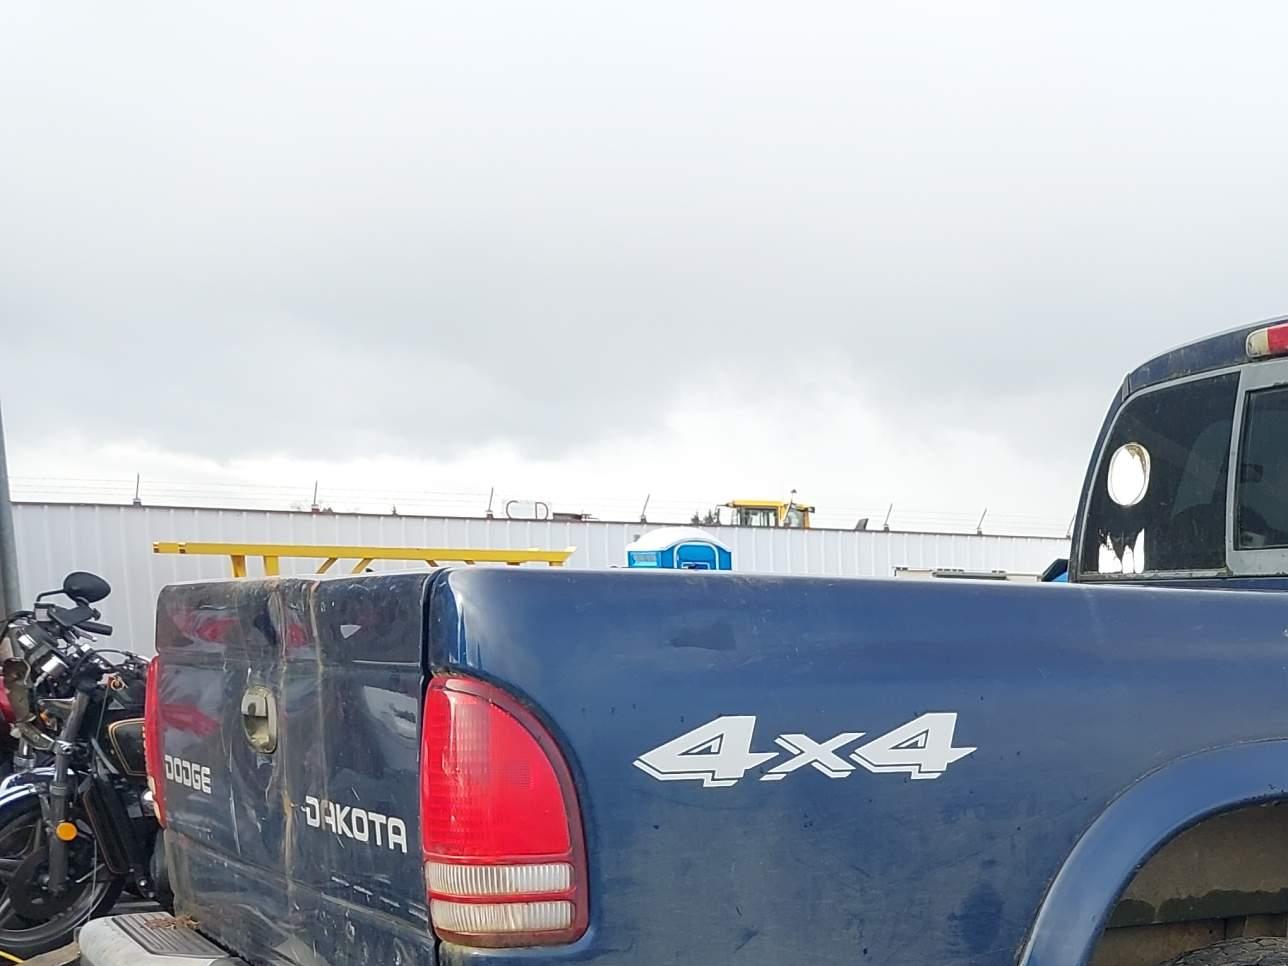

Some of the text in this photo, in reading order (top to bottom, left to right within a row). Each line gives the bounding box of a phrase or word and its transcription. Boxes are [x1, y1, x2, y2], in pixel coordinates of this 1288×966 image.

[164, 754, 212, 795] DODGE
[633, 712, 978, 788] 4x4
[304, 795, 408, 854] DAKOTA
